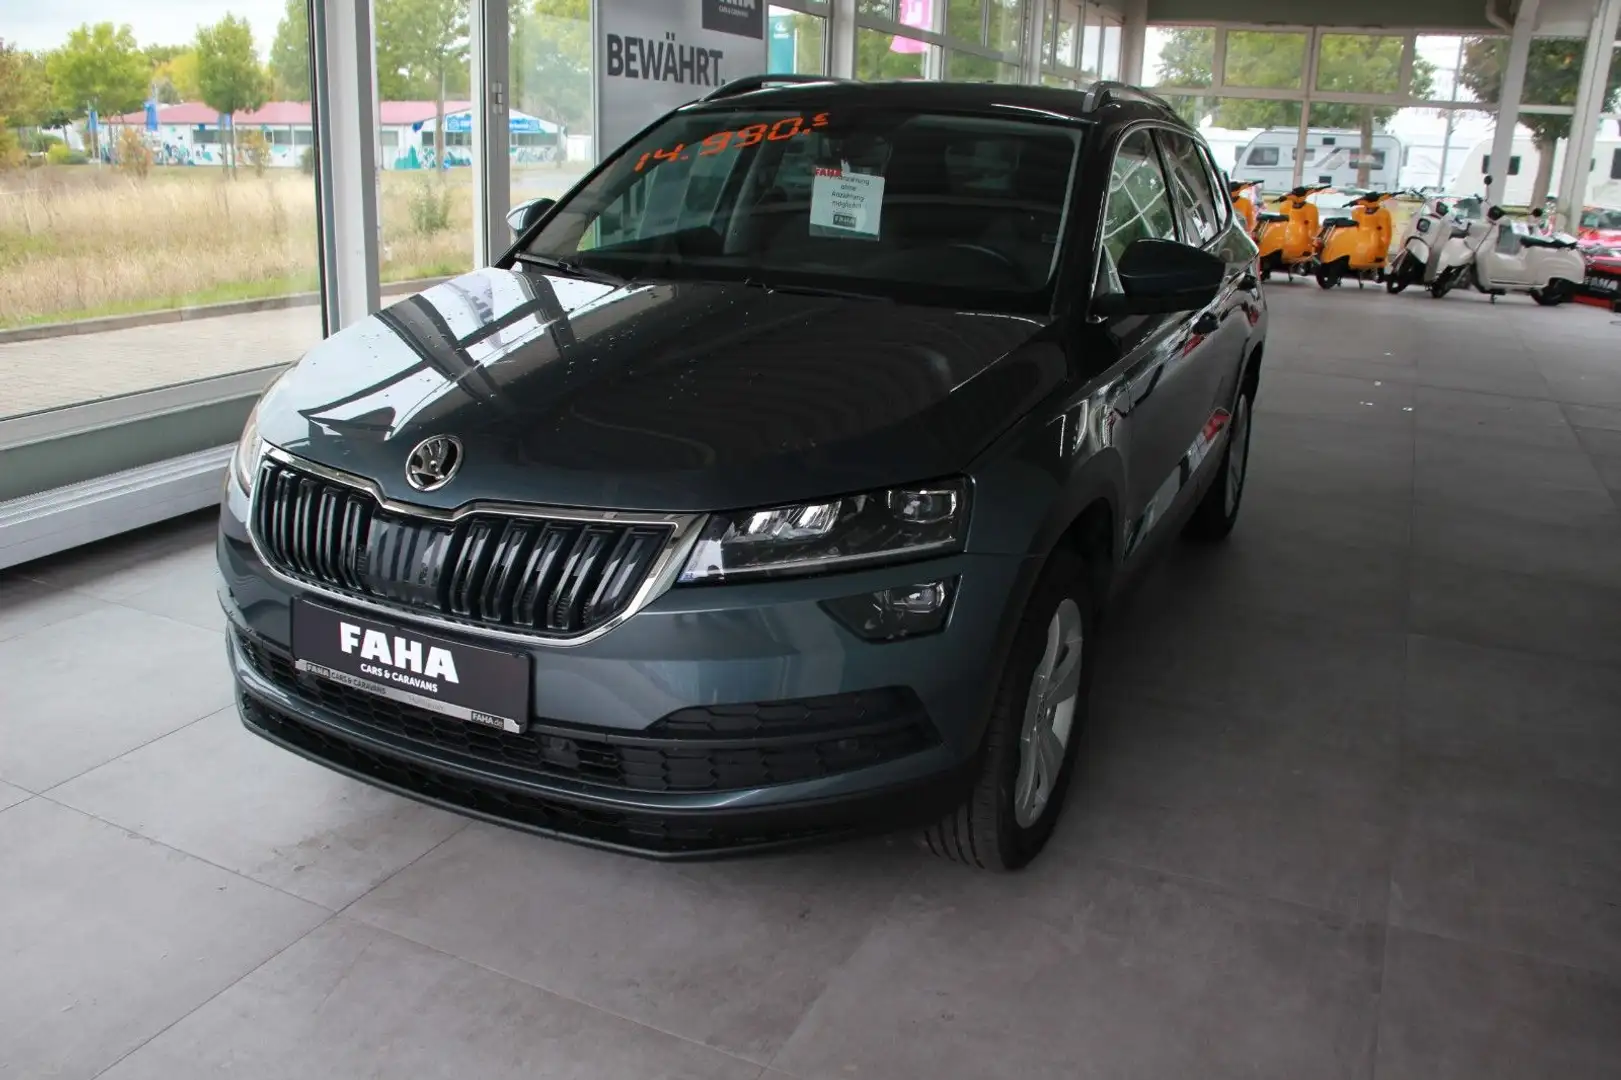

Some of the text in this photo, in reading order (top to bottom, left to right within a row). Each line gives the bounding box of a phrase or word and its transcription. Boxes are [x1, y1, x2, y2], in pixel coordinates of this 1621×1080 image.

[607, 31, 726, 87] BEWÄHRT.
[340, 622, 459, 684] FAHA
[307, 664, 329, 677] FAHA
[331, 672, 348, 684] CARS
[353, 680, 386, 694] CARAVANS
[360, 663, 438, 693] CARS & CARAVANS
[472, 712, 503, 729] FAHA.de
